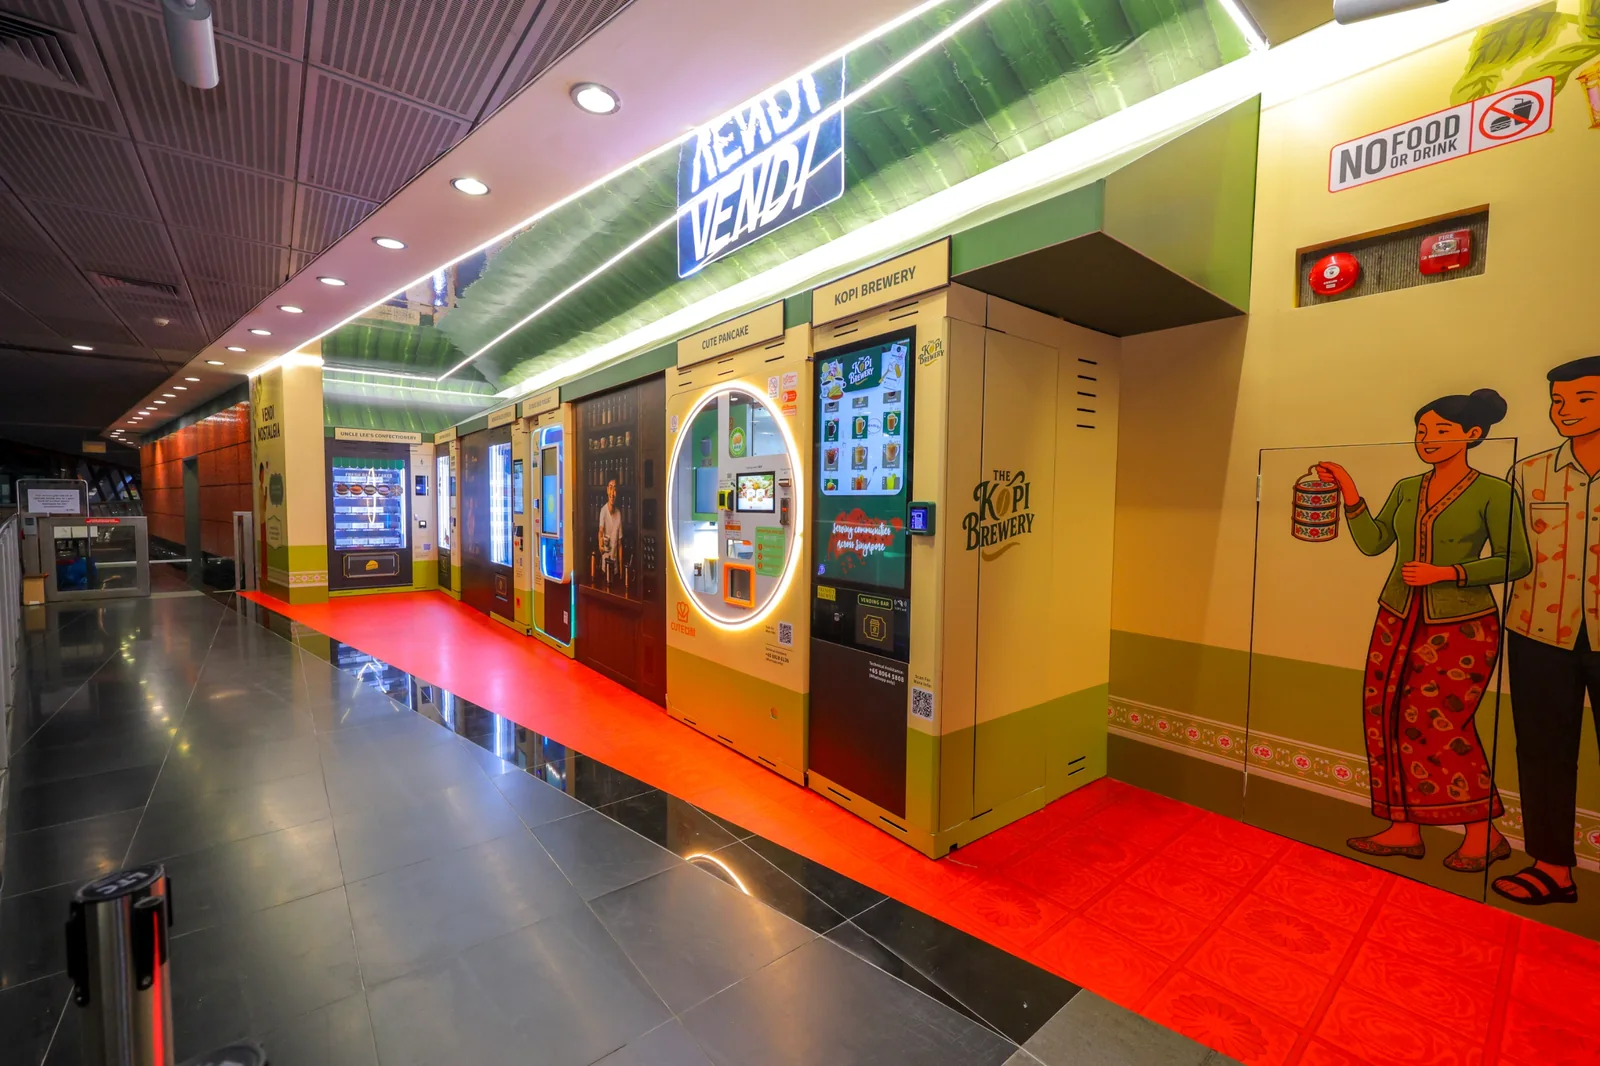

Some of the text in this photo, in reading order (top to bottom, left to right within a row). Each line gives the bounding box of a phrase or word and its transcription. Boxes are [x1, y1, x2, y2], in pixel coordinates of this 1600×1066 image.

[1339, 114, 1461, 184] NO FOOD
[1390, 138, 1458, 169] OR DRINK
[691, 122, 820, 262] VENDI
[1438, 233, 1455, 241] FIRE
[834, 265, 917, 306] KOPI BREWERY
[701, 324, 749, 350] CUTE PANCAKE
[921, 338, 942, 356] KOPI
[851, 355, 873, 374] KOPI
[918, 349, 945, 365] BREWERY
[848, 367, 875, 385] BREWERY
[261, 404, 275, 422] VENDI
[257, 422, 281, 442] NOSTALGIA
[993, 469, 1011, 482] THE
[973, 470, 1031, 522] KOPI
[962, 512, 1035, 551] BREWERY
[860, 597, 879, 605] VENDING
